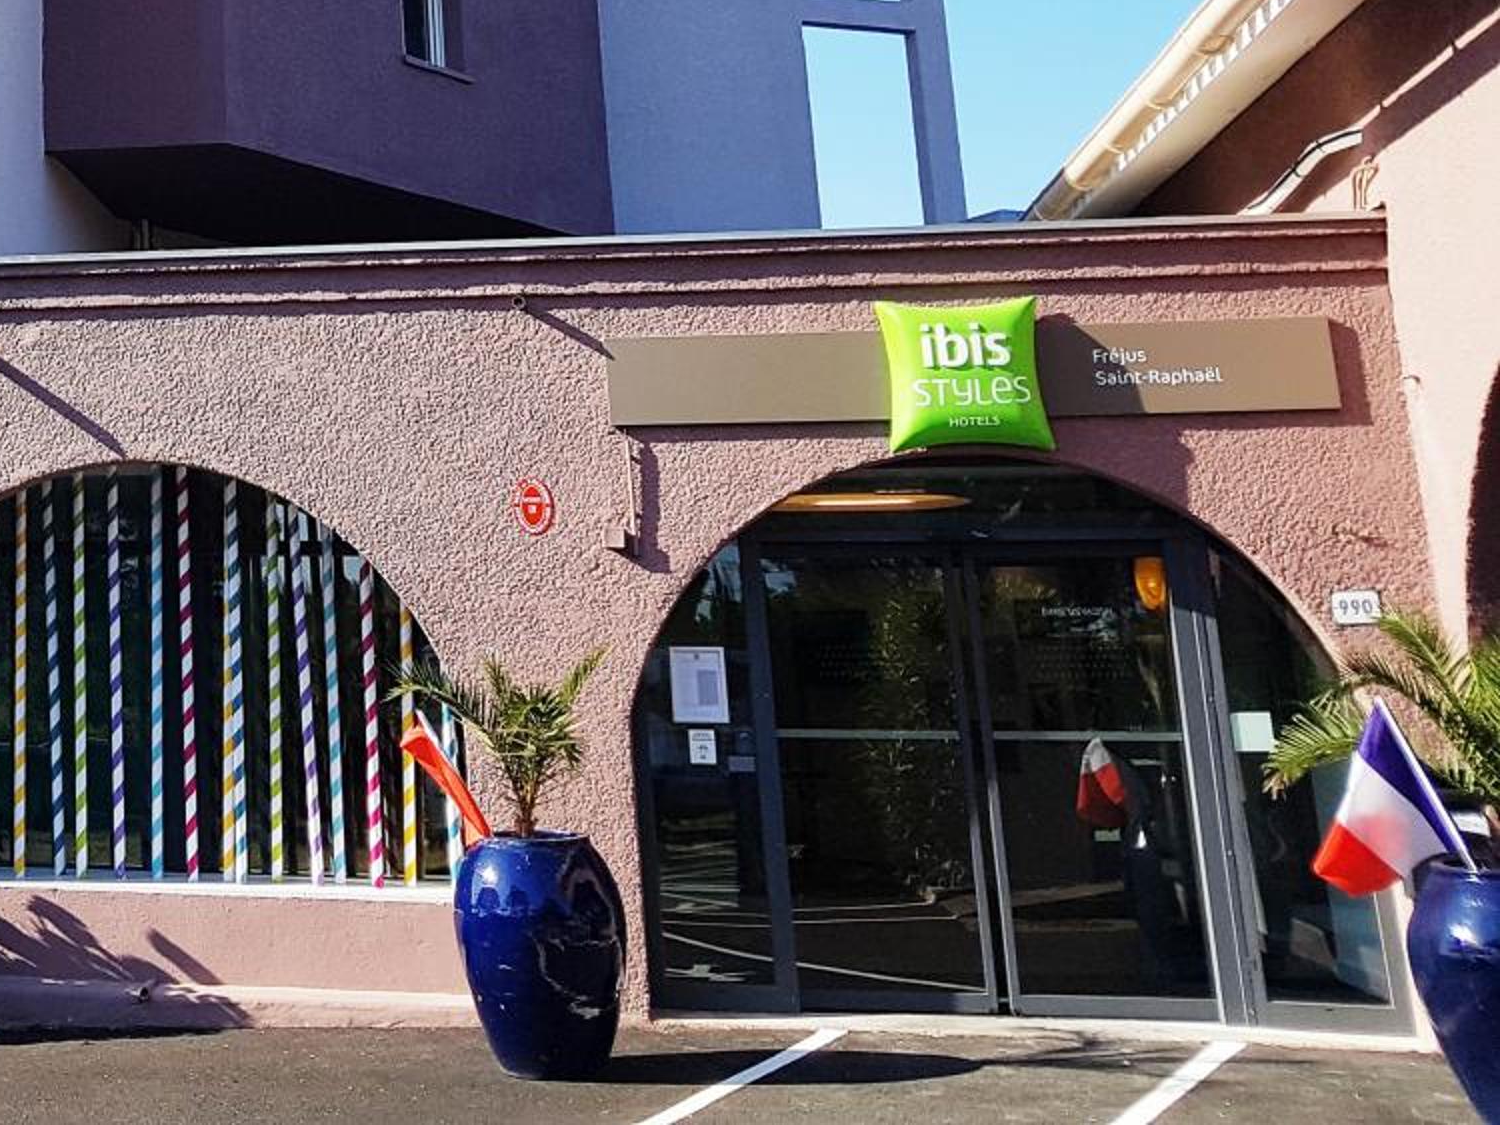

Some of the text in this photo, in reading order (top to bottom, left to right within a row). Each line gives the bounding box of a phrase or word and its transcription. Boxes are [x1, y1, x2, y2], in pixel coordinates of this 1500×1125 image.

[919, 322, 1011, 368] ibis
[1092, 346, 1147, 366] Fréjus
[1095, 366, 1224, 386] Saint-Raphaël
[950, 415, 1000, 428] HOTELS
[1339, 599, 1373, 615] 990
